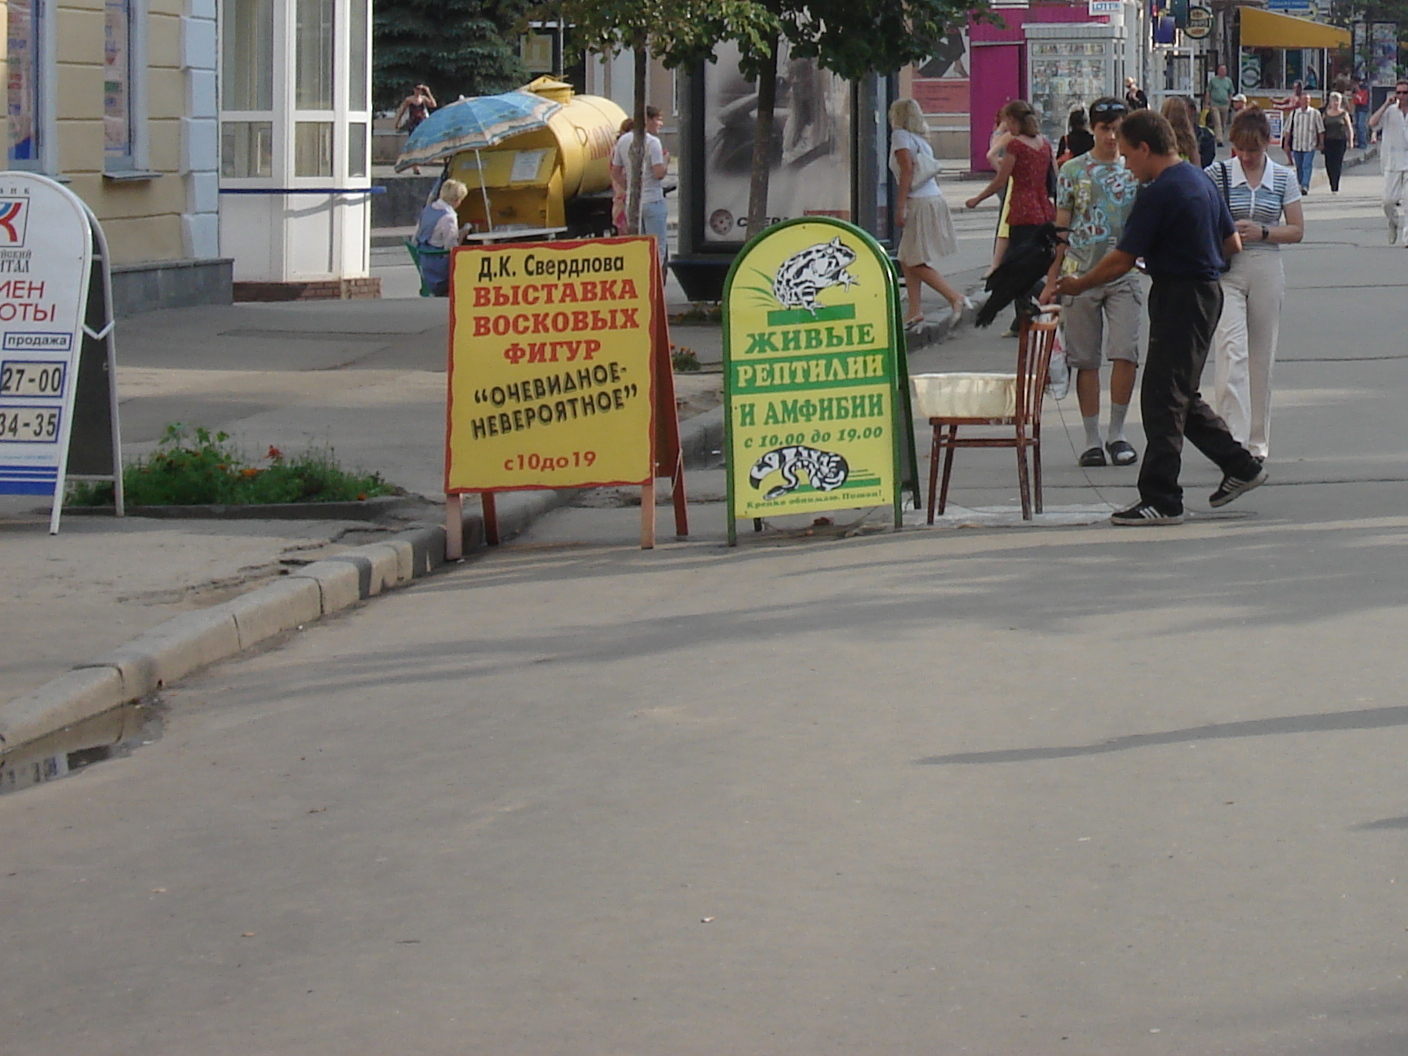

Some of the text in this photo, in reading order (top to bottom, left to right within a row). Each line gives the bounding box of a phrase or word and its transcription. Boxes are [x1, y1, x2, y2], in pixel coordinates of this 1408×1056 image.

[478, 254, 624, 282] Д.К. Свердлова
[473, 279, 638, 308] ВЫСТАВКА
[473, 308, 640, 337] ВОСКОВЫХ
[8, 337, 67, 346] продажа
[504, 339, 602, 364] ФИГУР
[745, 323, 875, 354] ЖИВЫЕ
[1, 367, 61, 392] 27-00
[736, 354, 884, 388] РЕПТИЛИИ
[740, 393, 884, 427] И АМФИБИИ
[758, 433, 805, 448] 10.00
[811, 429, 831, 443] до
[837, 426, 883, 442] 19.00
